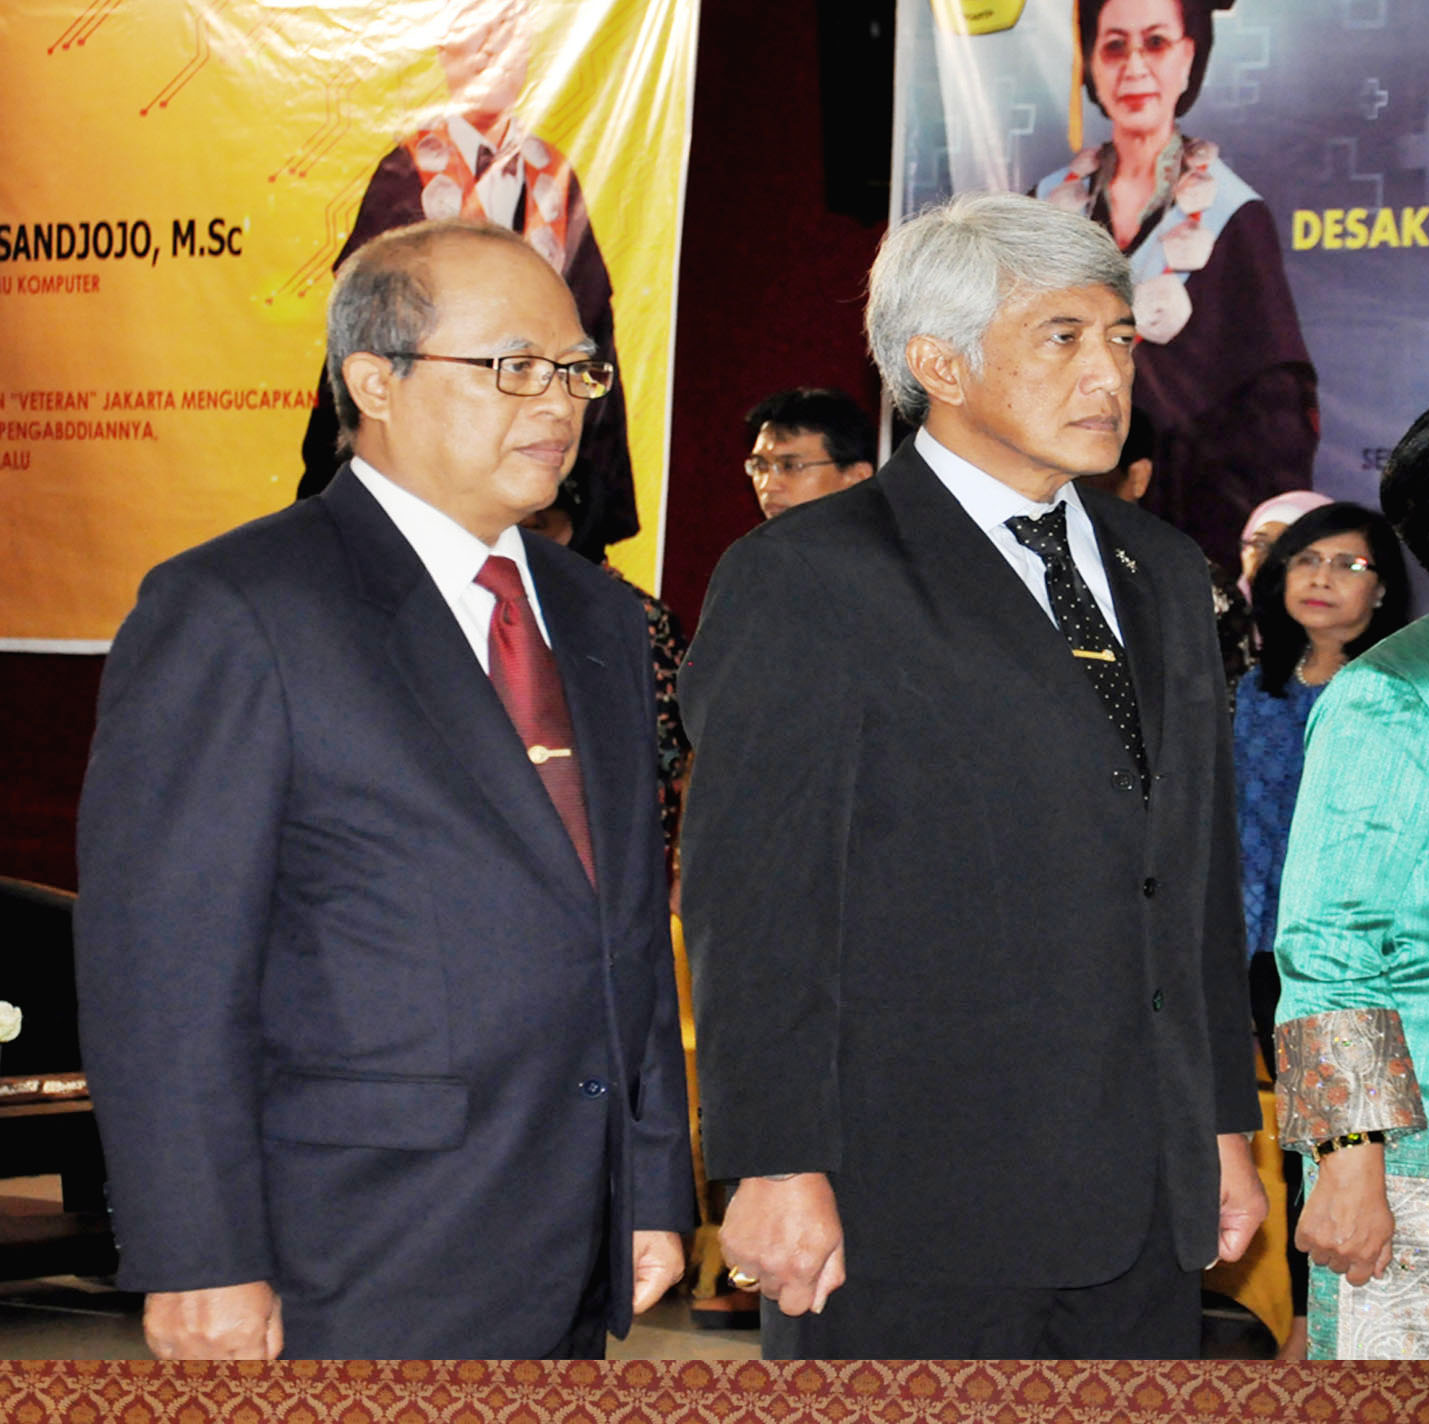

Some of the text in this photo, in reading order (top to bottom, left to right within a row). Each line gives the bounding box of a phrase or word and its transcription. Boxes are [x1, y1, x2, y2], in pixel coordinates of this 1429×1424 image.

[171, 217, 243, 258] M.Sc
[17, 274, 100, 294] KOMPUTER
[10, 390, 97, 411] "VETERAN"
[103, 390, 176, 412] JAKARTA
[181, 389, 319, 410] MENGUCAPKAN
